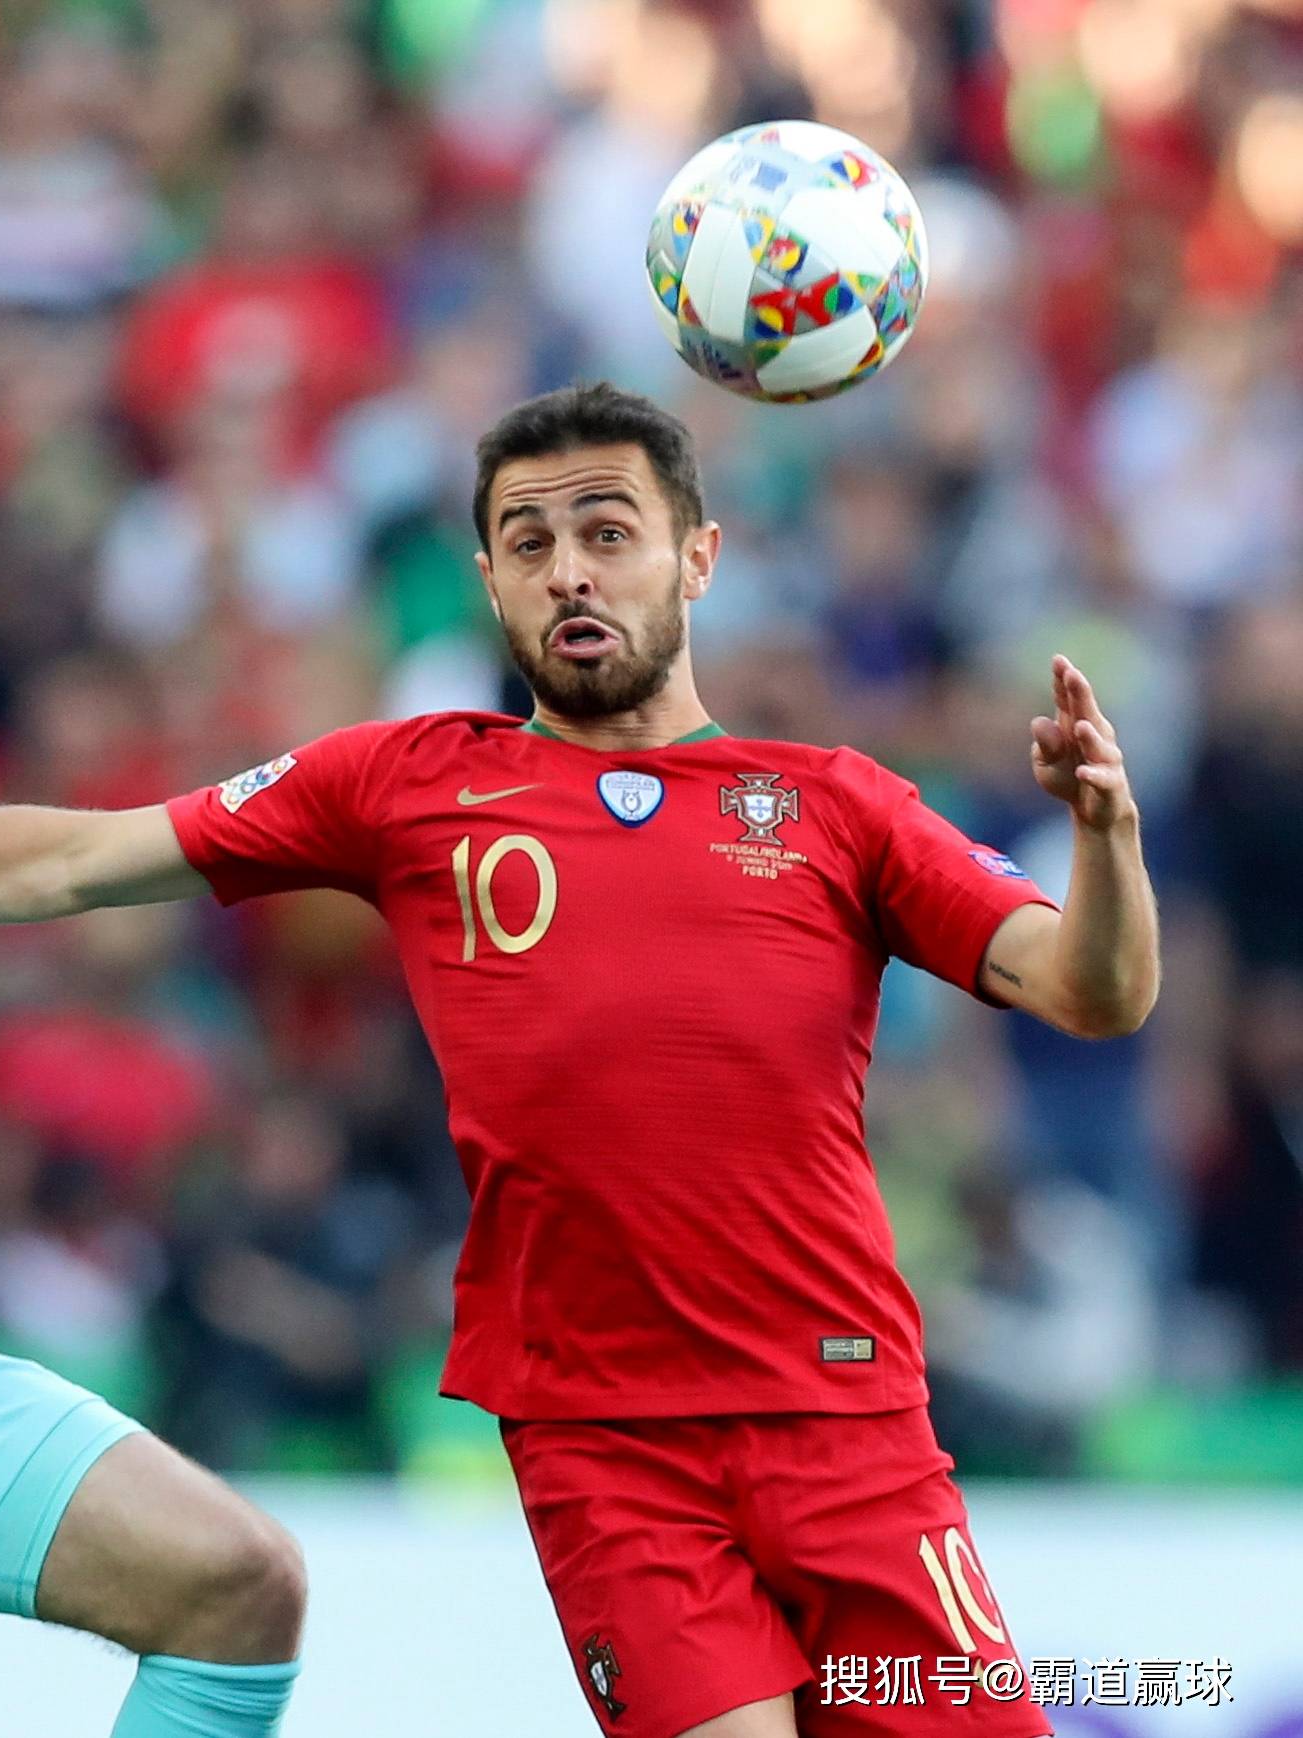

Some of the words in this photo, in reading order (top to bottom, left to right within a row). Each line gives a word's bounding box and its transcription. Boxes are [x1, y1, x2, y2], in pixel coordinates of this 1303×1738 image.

[451, 833, 558, 963] 10
[742, 865, 778, 879] PORTO
[918, 1527, 1007, 1655] 10
